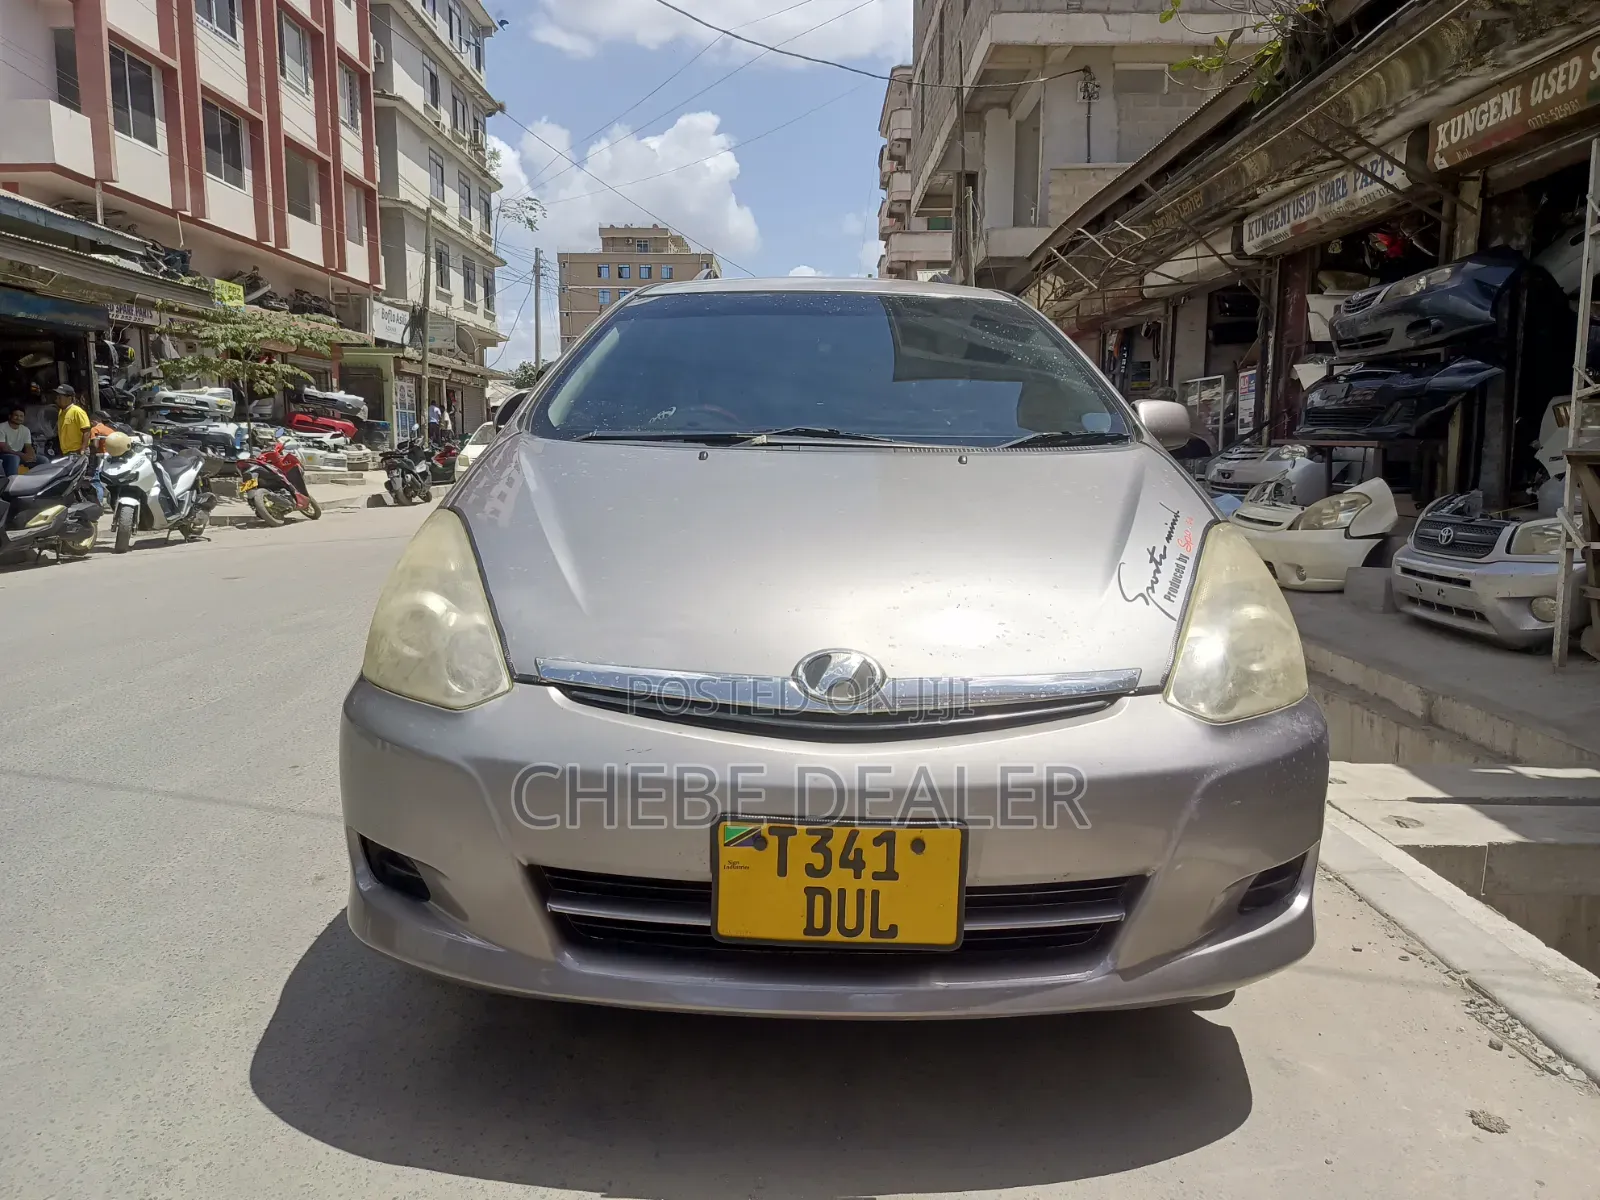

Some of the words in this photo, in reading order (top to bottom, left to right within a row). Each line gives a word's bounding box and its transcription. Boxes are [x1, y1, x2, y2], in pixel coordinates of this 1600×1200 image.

[1435, 84, 1522, 152] KUNGENI
[1530, 55, 1583, 107] USED
[1248, 205, 1291, 242] KUNGENI
[1292, 190, 1317, 219] USED
[1318, 176, 1348, 206] SPARE
[1163, 561, 1186, 603] Produced
[1176, 552, 1190, 564] by
[768, 827, 900, 882] T341
[803, 886, 899, 940] DUL
